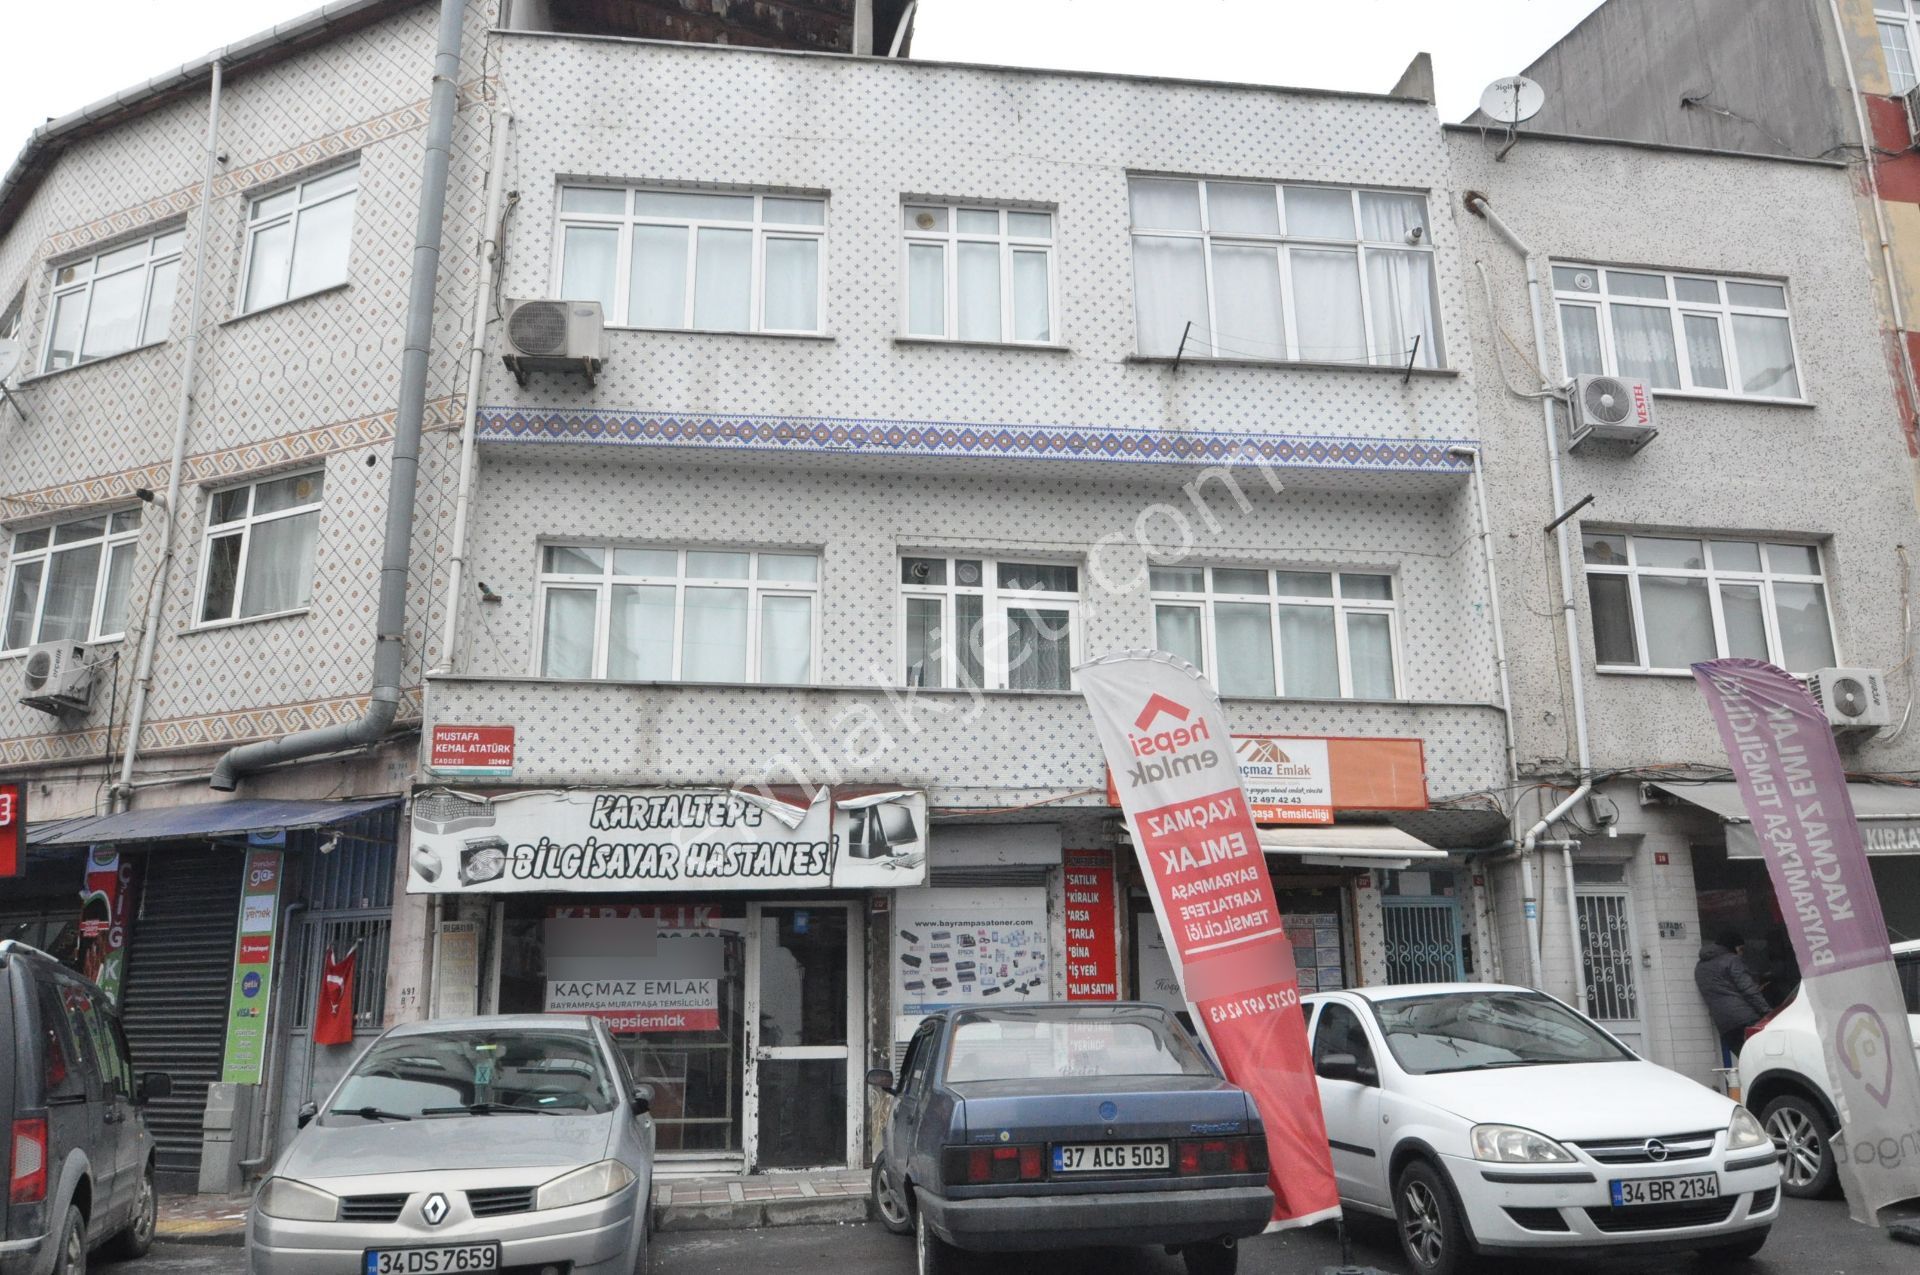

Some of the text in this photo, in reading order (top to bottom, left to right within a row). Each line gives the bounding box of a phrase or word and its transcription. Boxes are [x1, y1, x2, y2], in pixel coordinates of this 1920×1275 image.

[1633, 384, 1648, 424] VESTEL
[436, 732, 479, 741] MUSTAFA
[435, 743, 511, 753] KEMAL ATATÜRK
[1276, 763, 1311, 776] Emlak
[590, 794, 763, 831] KARTALTEPE
[512, 834, 840, 880] BİLGİSAYAR HASTANESİ
[1070, 874, 1097, 885] SATILIK
[1070, 890, 1099, 903] KİRALIK
[1070, 910, 1090, 921] ARSA
[915, 919, 1034, 928] www.bayrampasatoner.com
[1071, 928, 1095, 940] TARLA
[1071, 944, 1090, 958] BİNA
[1071, 961, 1097, 979] İŞ YERİ
[554, 981, 710, 998] KAÇMAZ EMLAK
[1071, 983, 1114, 995] ALIM SATIM
[550, 998, 713, 1010] BAYRAMPAŞA MURATPAŞA TEMSİLCİLİĞİ
[602, 1015, 685, 1030] hepsiemlak
[1064, 1148, 1085, 1169] 37
[1093, 1147, 1126, 1168] ACG
[1132, 1146, 1165, 1166] 503
[1623, 1183, 1645, 1202] 34
[1649, 1181, 1675, 1200] BR
[1679, 1177, 1716, 1199] 2134
[380, 1253, 404, 1274] 34
[408, 1251, 439, 1273] DS
[443, 1247, 495, 1271] 7659
